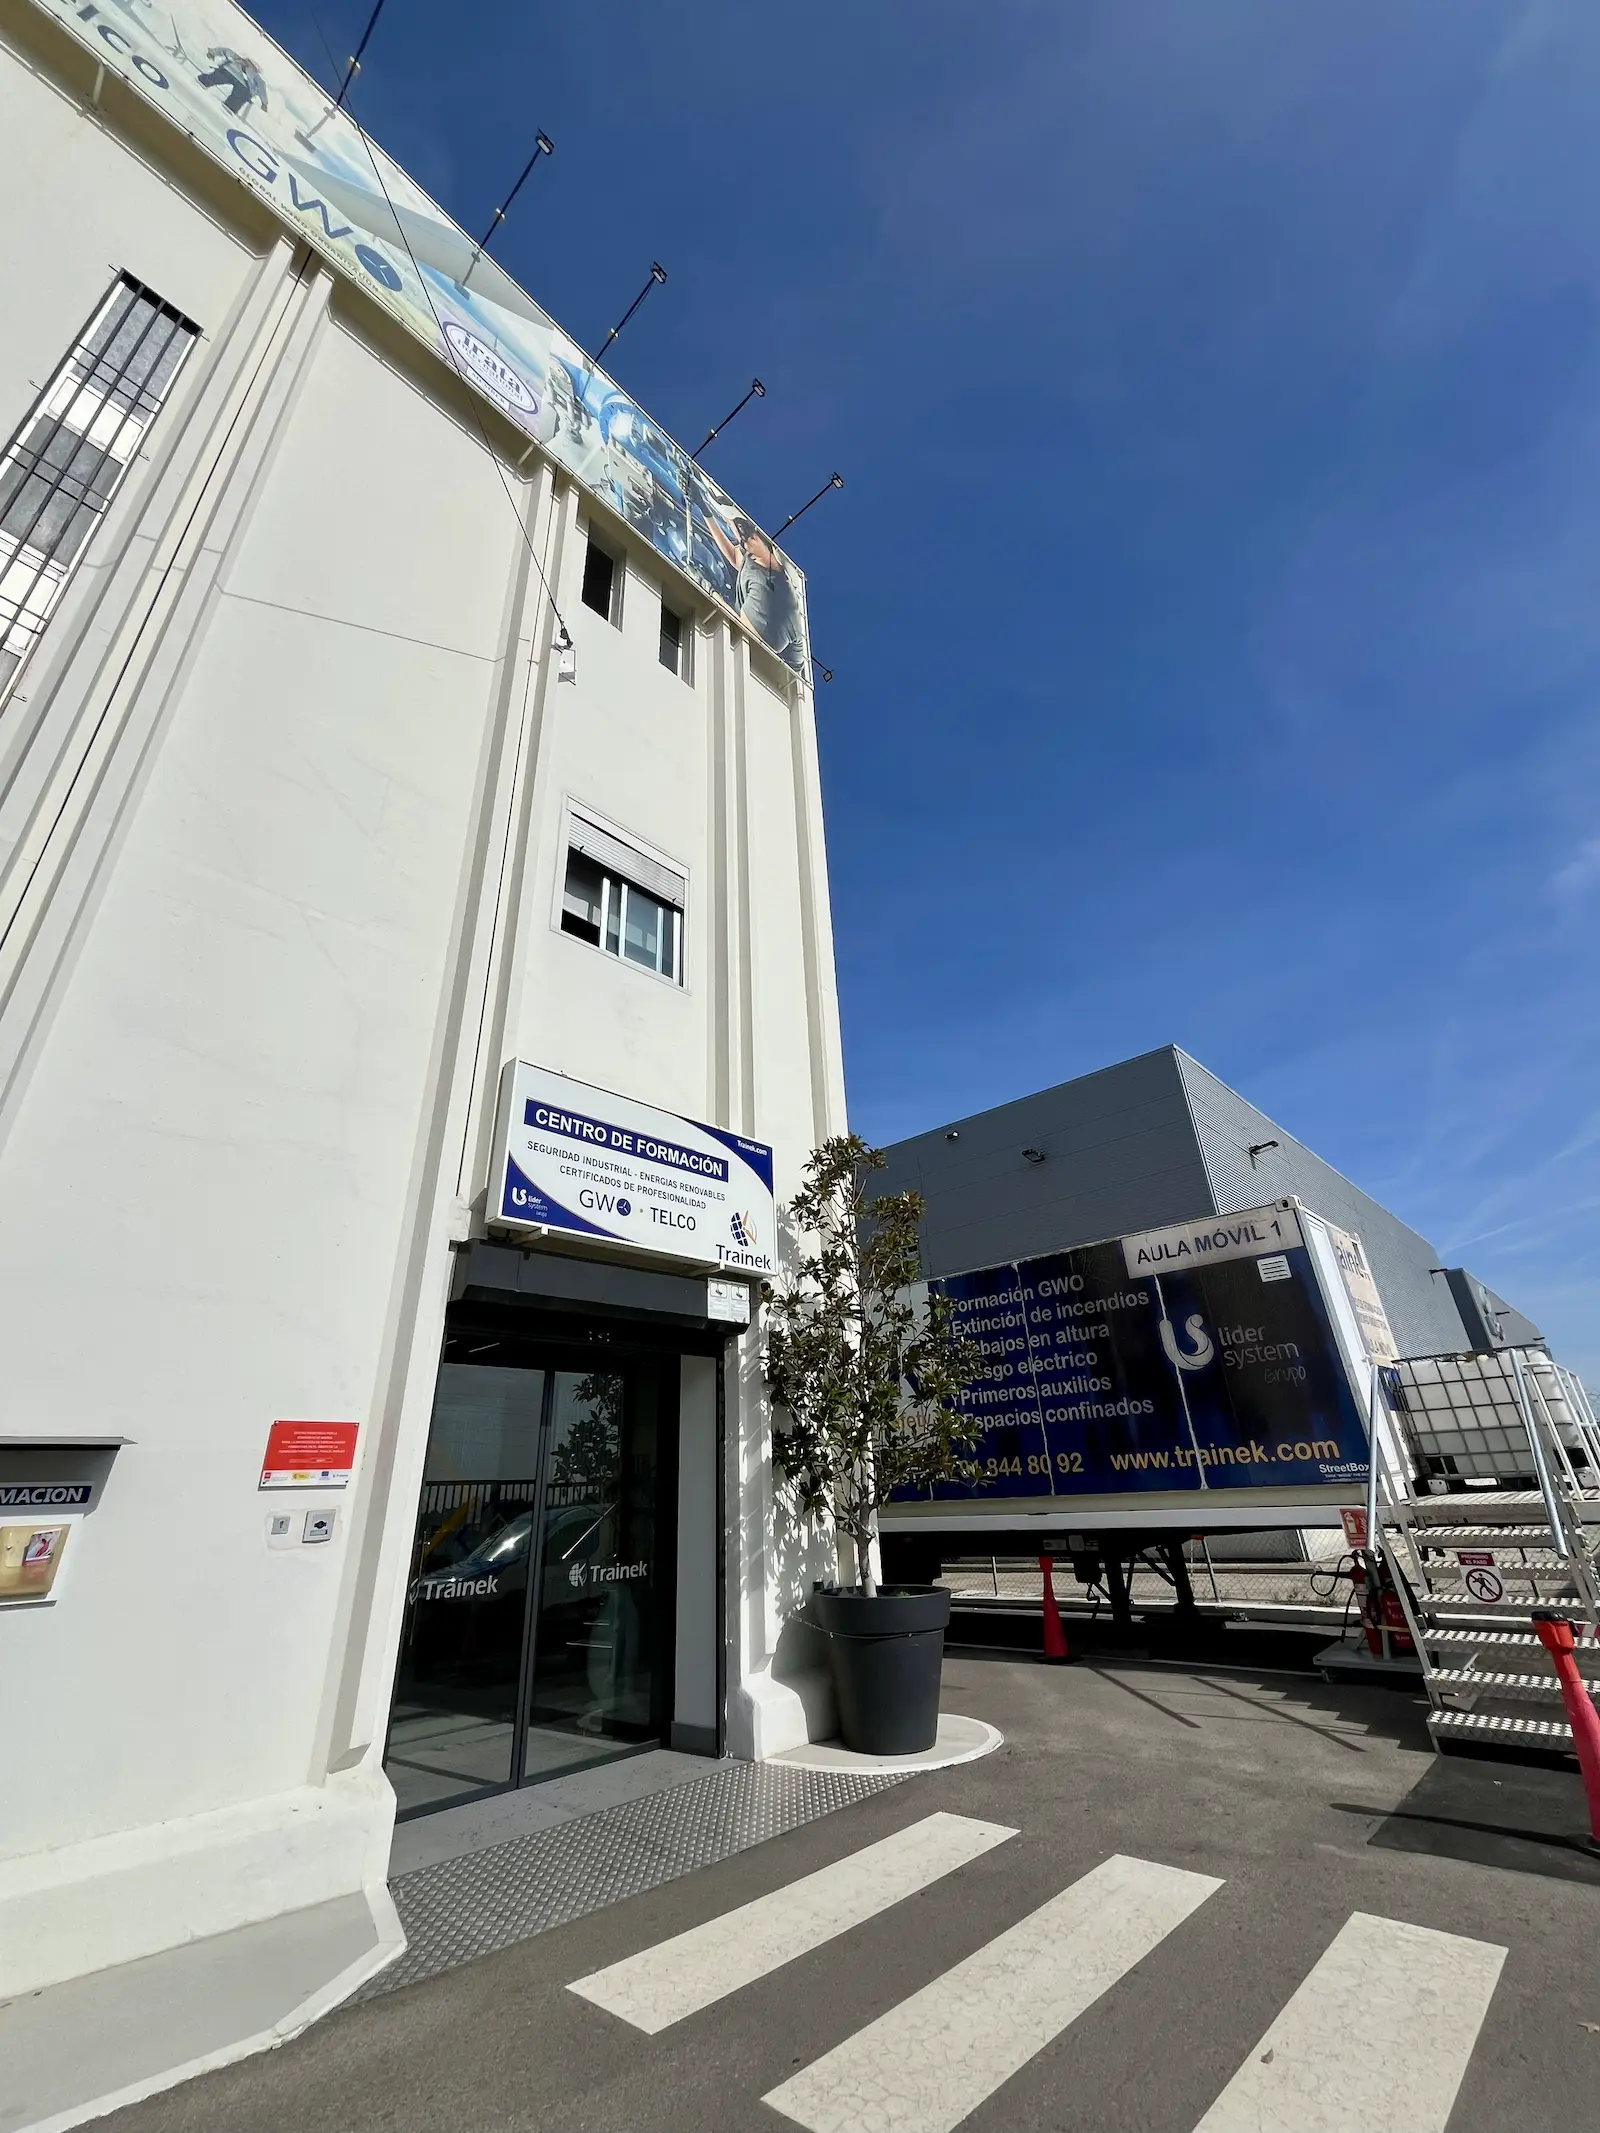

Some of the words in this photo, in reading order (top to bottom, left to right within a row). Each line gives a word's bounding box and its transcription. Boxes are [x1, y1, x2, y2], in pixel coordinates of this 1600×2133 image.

[60, 0, 170, 90] ICO
[280, 203, 311, 231] WIND
[464, 332, 522, 395] irata
[535, 1108, 607, 1142] CENTRO
[611, 1131, 633, 1151] DE
[636, 1138, 723, 1177] FORMACIÓN
[527, 1140, 580, 1162] SEGURIDAD
[582, 1153, 632, 1177] INDUSTRIAL
[639, 1172, 678, 1189] ENERGIAS
[679, 1182, 726, 1201] RENOVABLES
[559, 1164, 622, 1188] CERTIFICADOS
[624, 1181, 635, 1191] DE
[637, 1185, 707, 1210] PROFESIONALIDAD
[650, 1206, 696, 1231] TELCO
[1137, 1240, 1191, 1265] AULA
[1194, 1225, 1265, 1254] MÓVIL
[1270, 1220, 1281, 1237] 1
[715, 1243, 772, 1271] Trainek
[1037, 1274, 1085, 1298] GWO
[952, 1310, 1027, 1337] Extinción
[1031, 1303, 1053, 1323] de
[1056, 1290, 1149, 1319] incendios
[966, 1336, 1025, 1358] bajos
[1029, 1333, 1051, 1348] en
[1056, 1323, 1110, 1345] altura
[1218, 1326, 1266, 1346] lider
[1017, 1351, 1099, 1374] eléctrico
[1223, 1342, 1300, 1370] system
[1264, 1365, 1307, 1387] Grupo
[961, 1384, 1037, 1406] Primeros
[1040, 1376, 1113, 1397] auxilios
[1045, 1396, 1155, 1423] confinados
[986, 1456, 1023, 1477] 844
[1028, 1454, 1051, 1475] 80
[1058, 1452, 1085, 1474] 92
[1110, 1439, 1340, 1471] www.trainek.com
[590, 1560, 648, 1583] Trainek
[424, 1575, 498, 1600] Trainek
